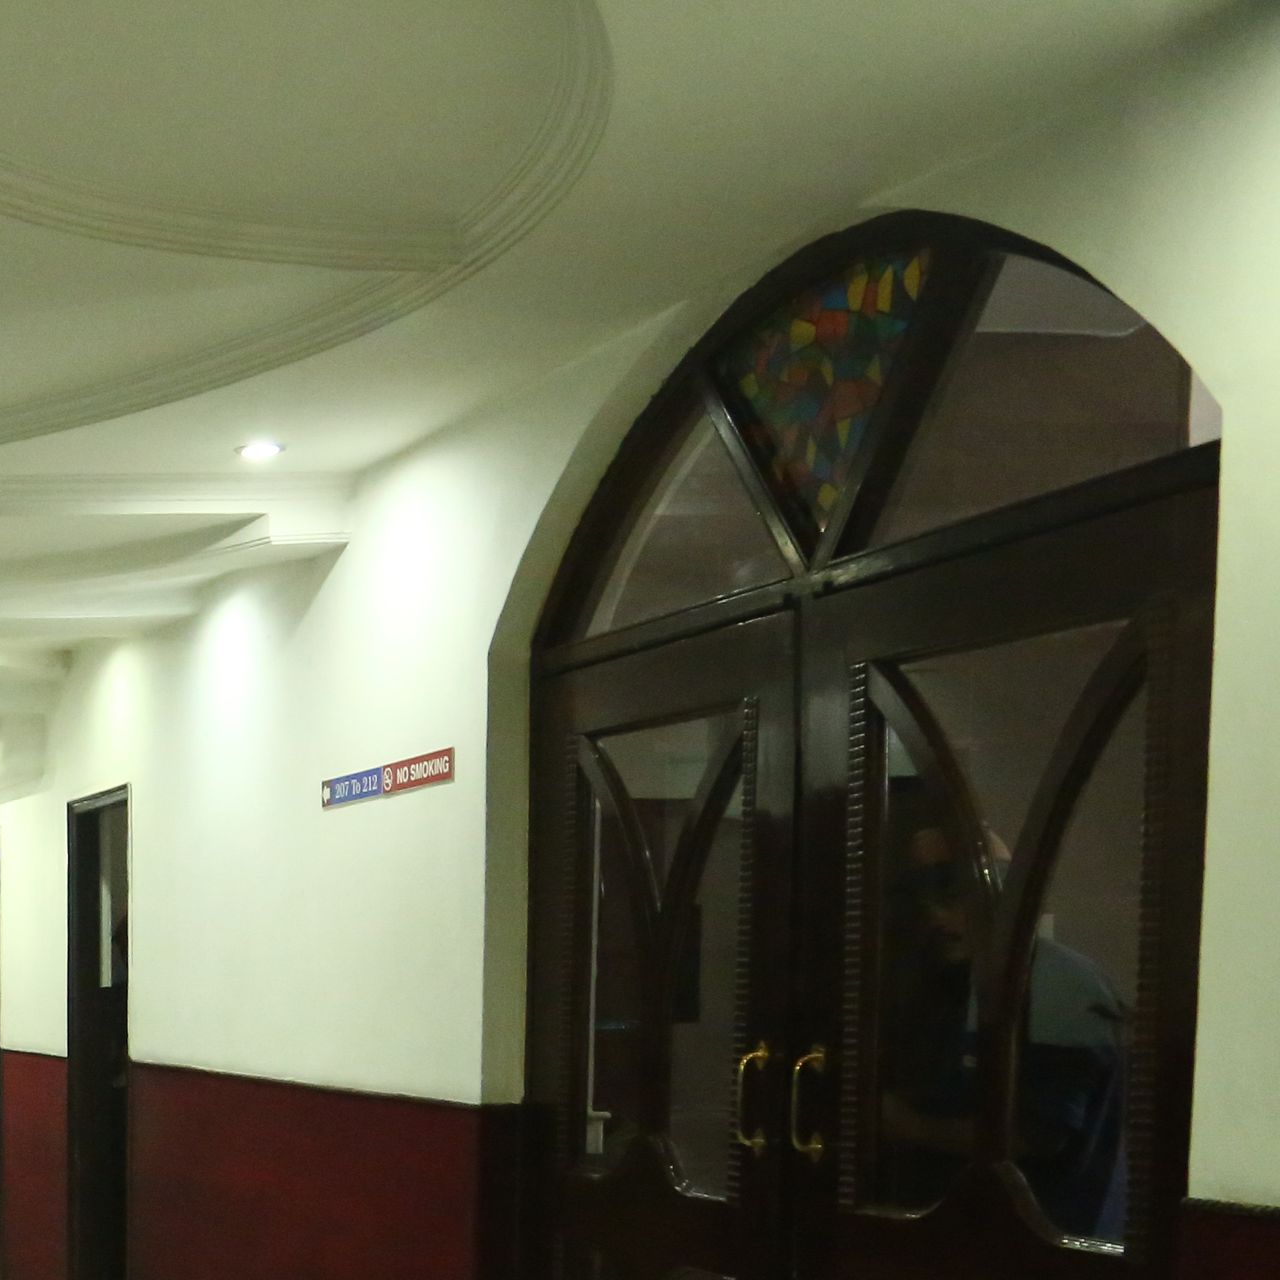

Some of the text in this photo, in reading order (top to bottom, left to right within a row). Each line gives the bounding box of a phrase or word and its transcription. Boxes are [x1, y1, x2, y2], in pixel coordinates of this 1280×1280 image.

[397, 755, 450, 785] NO SMOKING
[335, 774, 378, 799] 207 To 212
